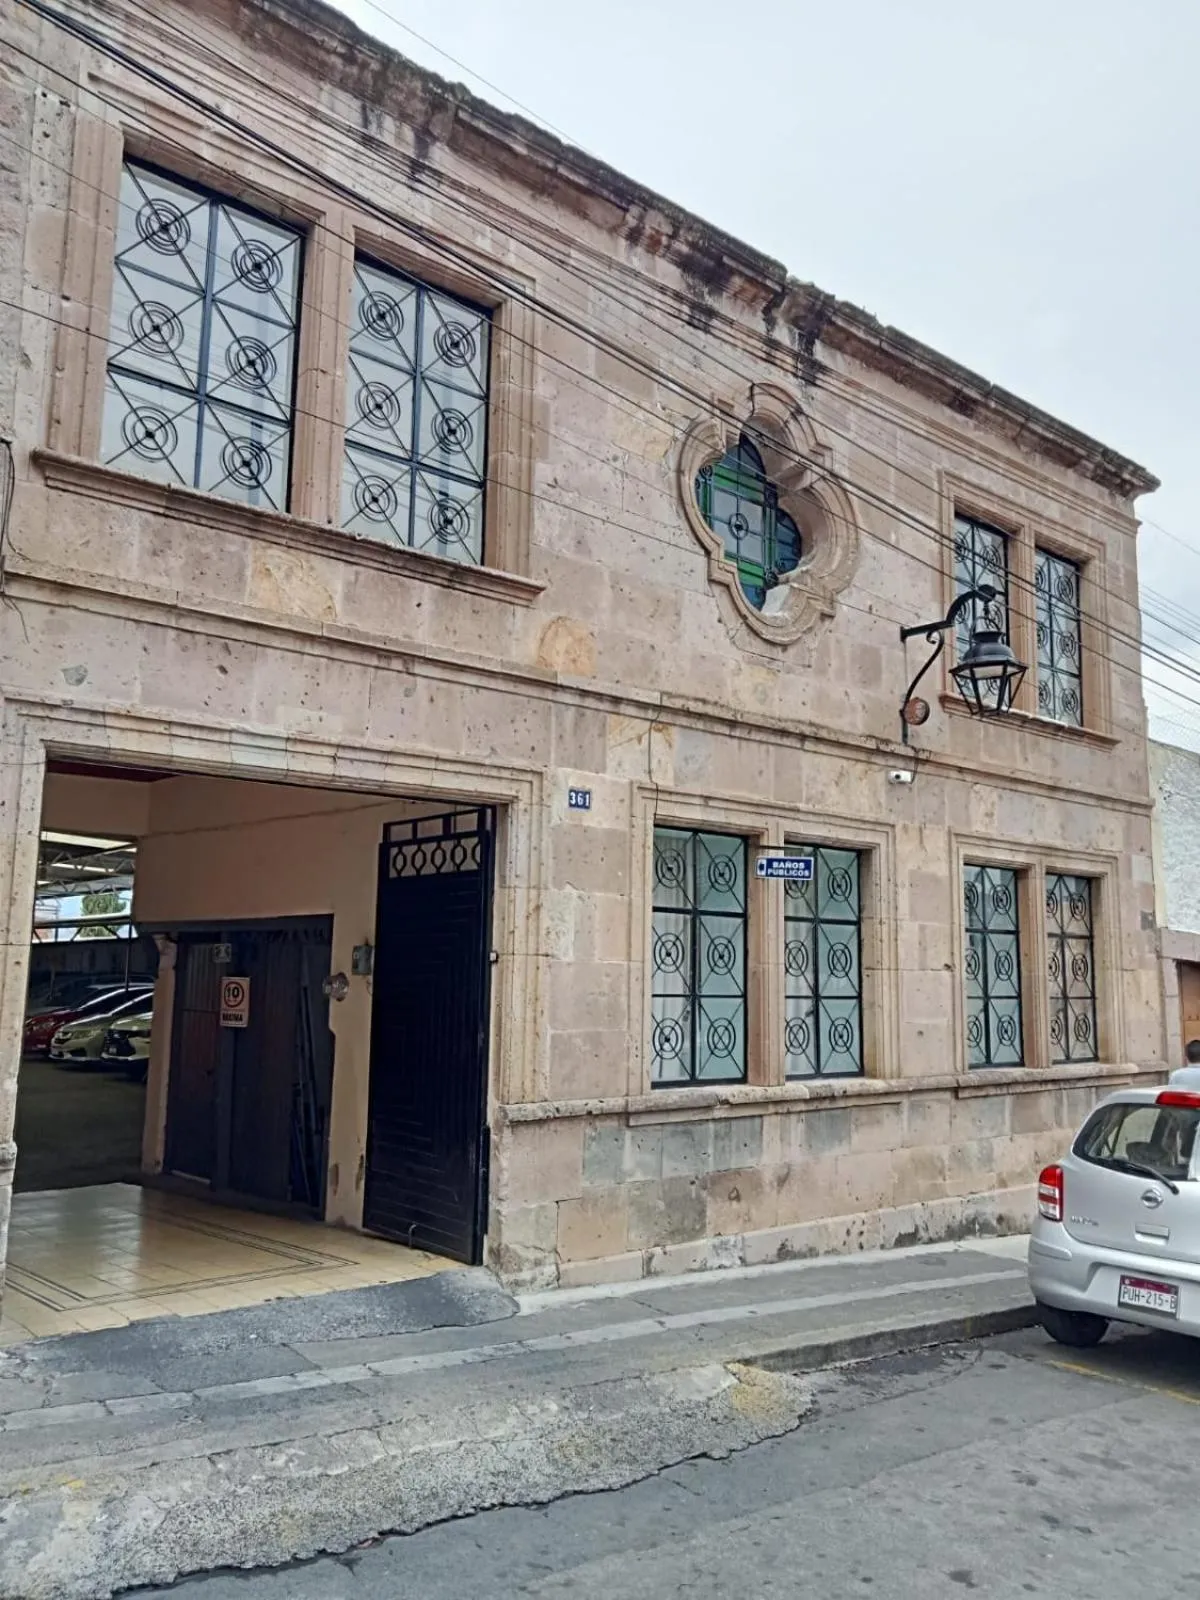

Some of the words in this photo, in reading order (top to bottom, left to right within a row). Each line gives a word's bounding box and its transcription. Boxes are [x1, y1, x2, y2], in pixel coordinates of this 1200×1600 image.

[570, 791, 589, 806] 361
[772, 861, 805, 869] BAÑOS
[226, 986, 240, 998] 10
